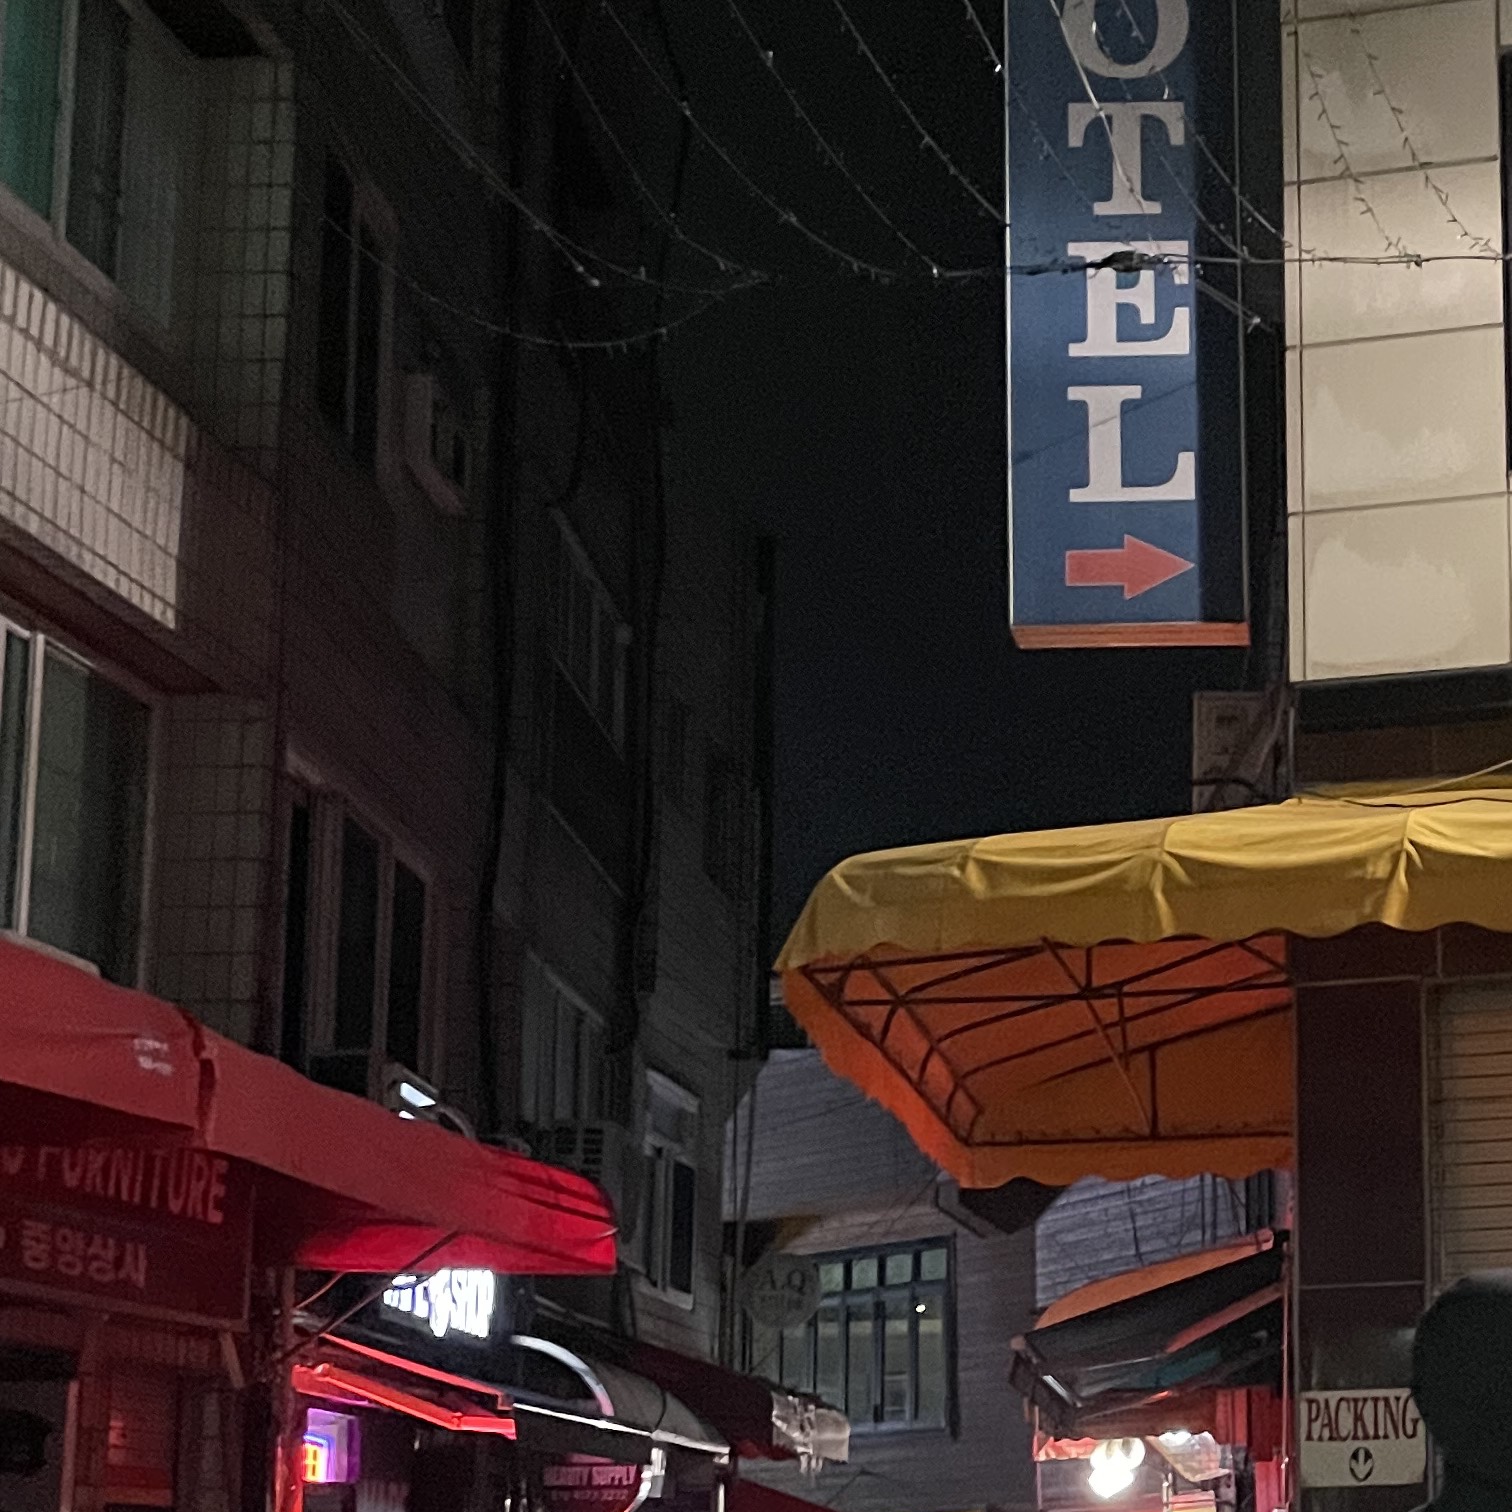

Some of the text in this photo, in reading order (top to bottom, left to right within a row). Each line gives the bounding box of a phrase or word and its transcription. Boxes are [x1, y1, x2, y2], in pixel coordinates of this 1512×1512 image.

[21, 1219, 148, 1289] 중앙상사
[1304, 1396, 1421, 1443] PACKING
[592, 1464, 637, 1486] SUPPLY
